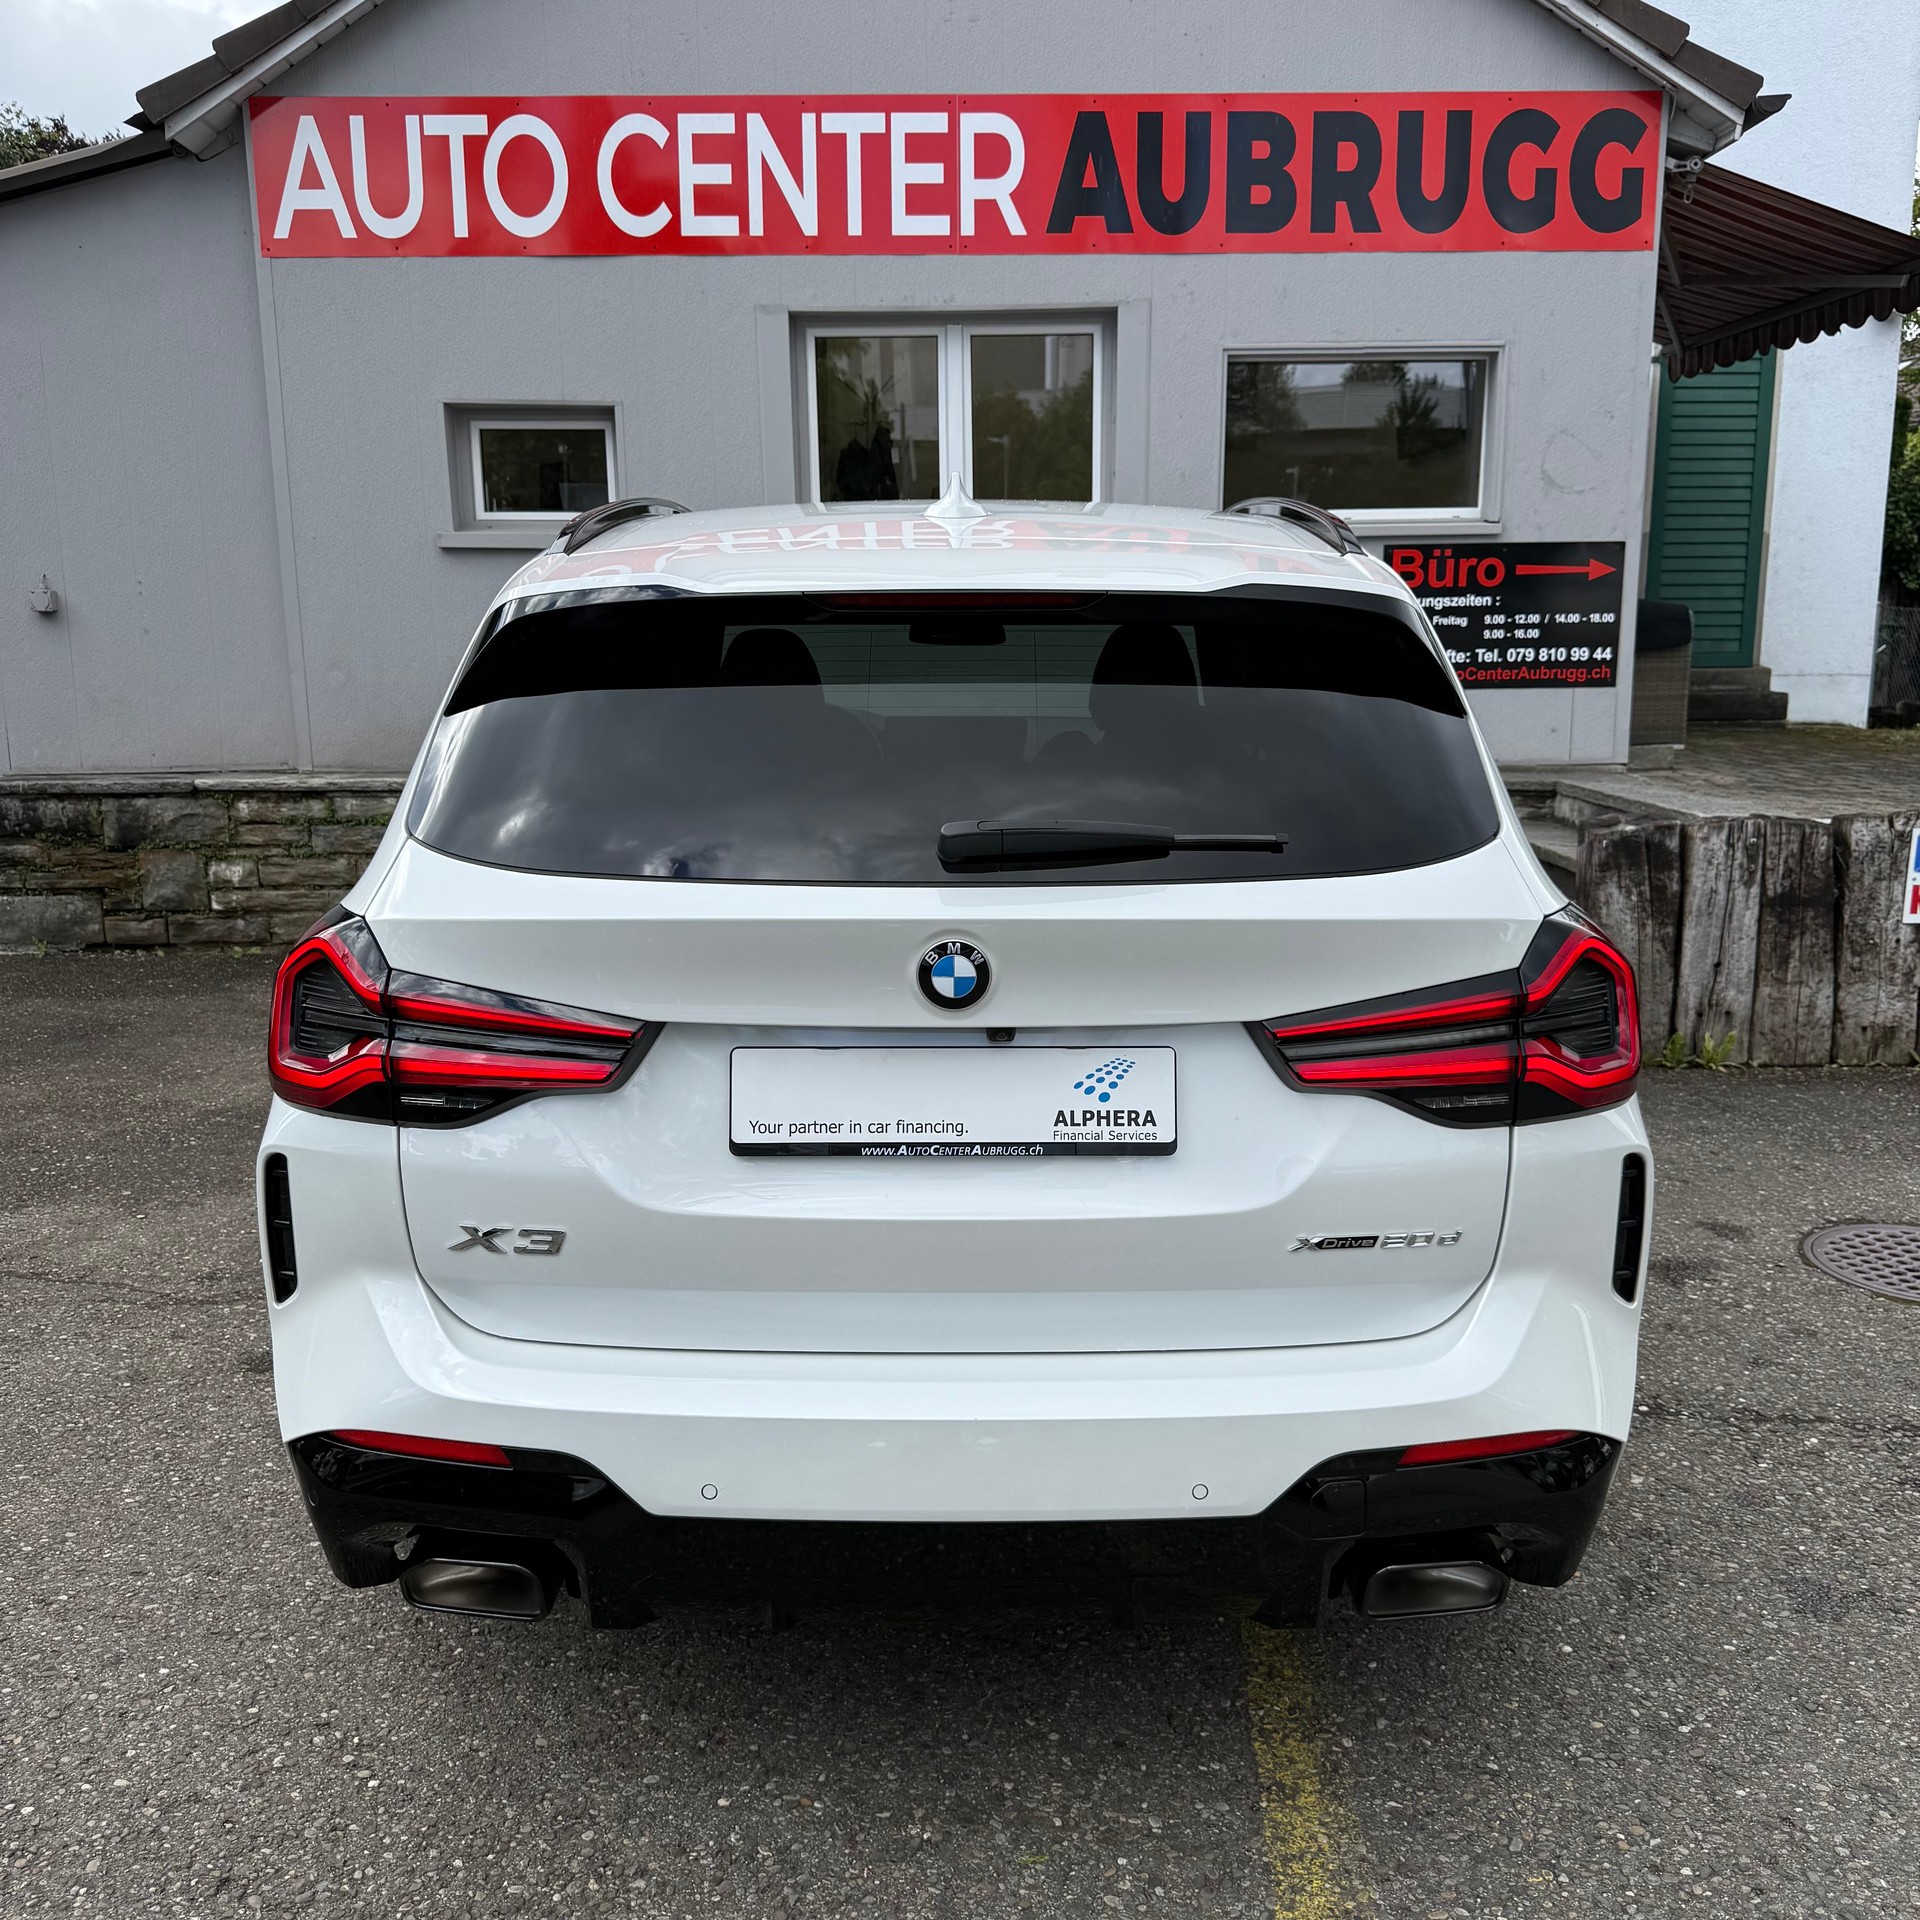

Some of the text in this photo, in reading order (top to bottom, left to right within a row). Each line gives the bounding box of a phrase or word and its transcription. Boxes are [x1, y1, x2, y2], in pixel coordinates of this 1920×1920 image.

[273, 107, 1649, 240] AUTO CENTER AUBRUGG
[1391, 548, 1506, 588] Büro
[1417, 594, 1493, 610] ungszeiten
[1432, 615, 1469, 627] Freitag
[1483, 614, 1506, 625] 9.00
[1514, 613, 1541, 624] 12.00
[1554, 613, 1581, 624] 14.00
[1588, 612, 1616, 623] 18.00
[1483, 628, 1505, 639] 9.00
[1513, 628, 1540, 639] 16.00
[1446, 646, 1614, 663] fte: Tel. 079 810 99 44
[1456, 664, 1612, 683] oCenterAubrugg.ch
[924, 942, 985, 966] BMW
[1053, 1109, 1158, 1127] ALPHERA
[749, 1119, 970, 1137] Your partner in car financing.
[1053, 1130, 1158, 1141] Financial Services
[447, 1222, 567, 1255] X3
